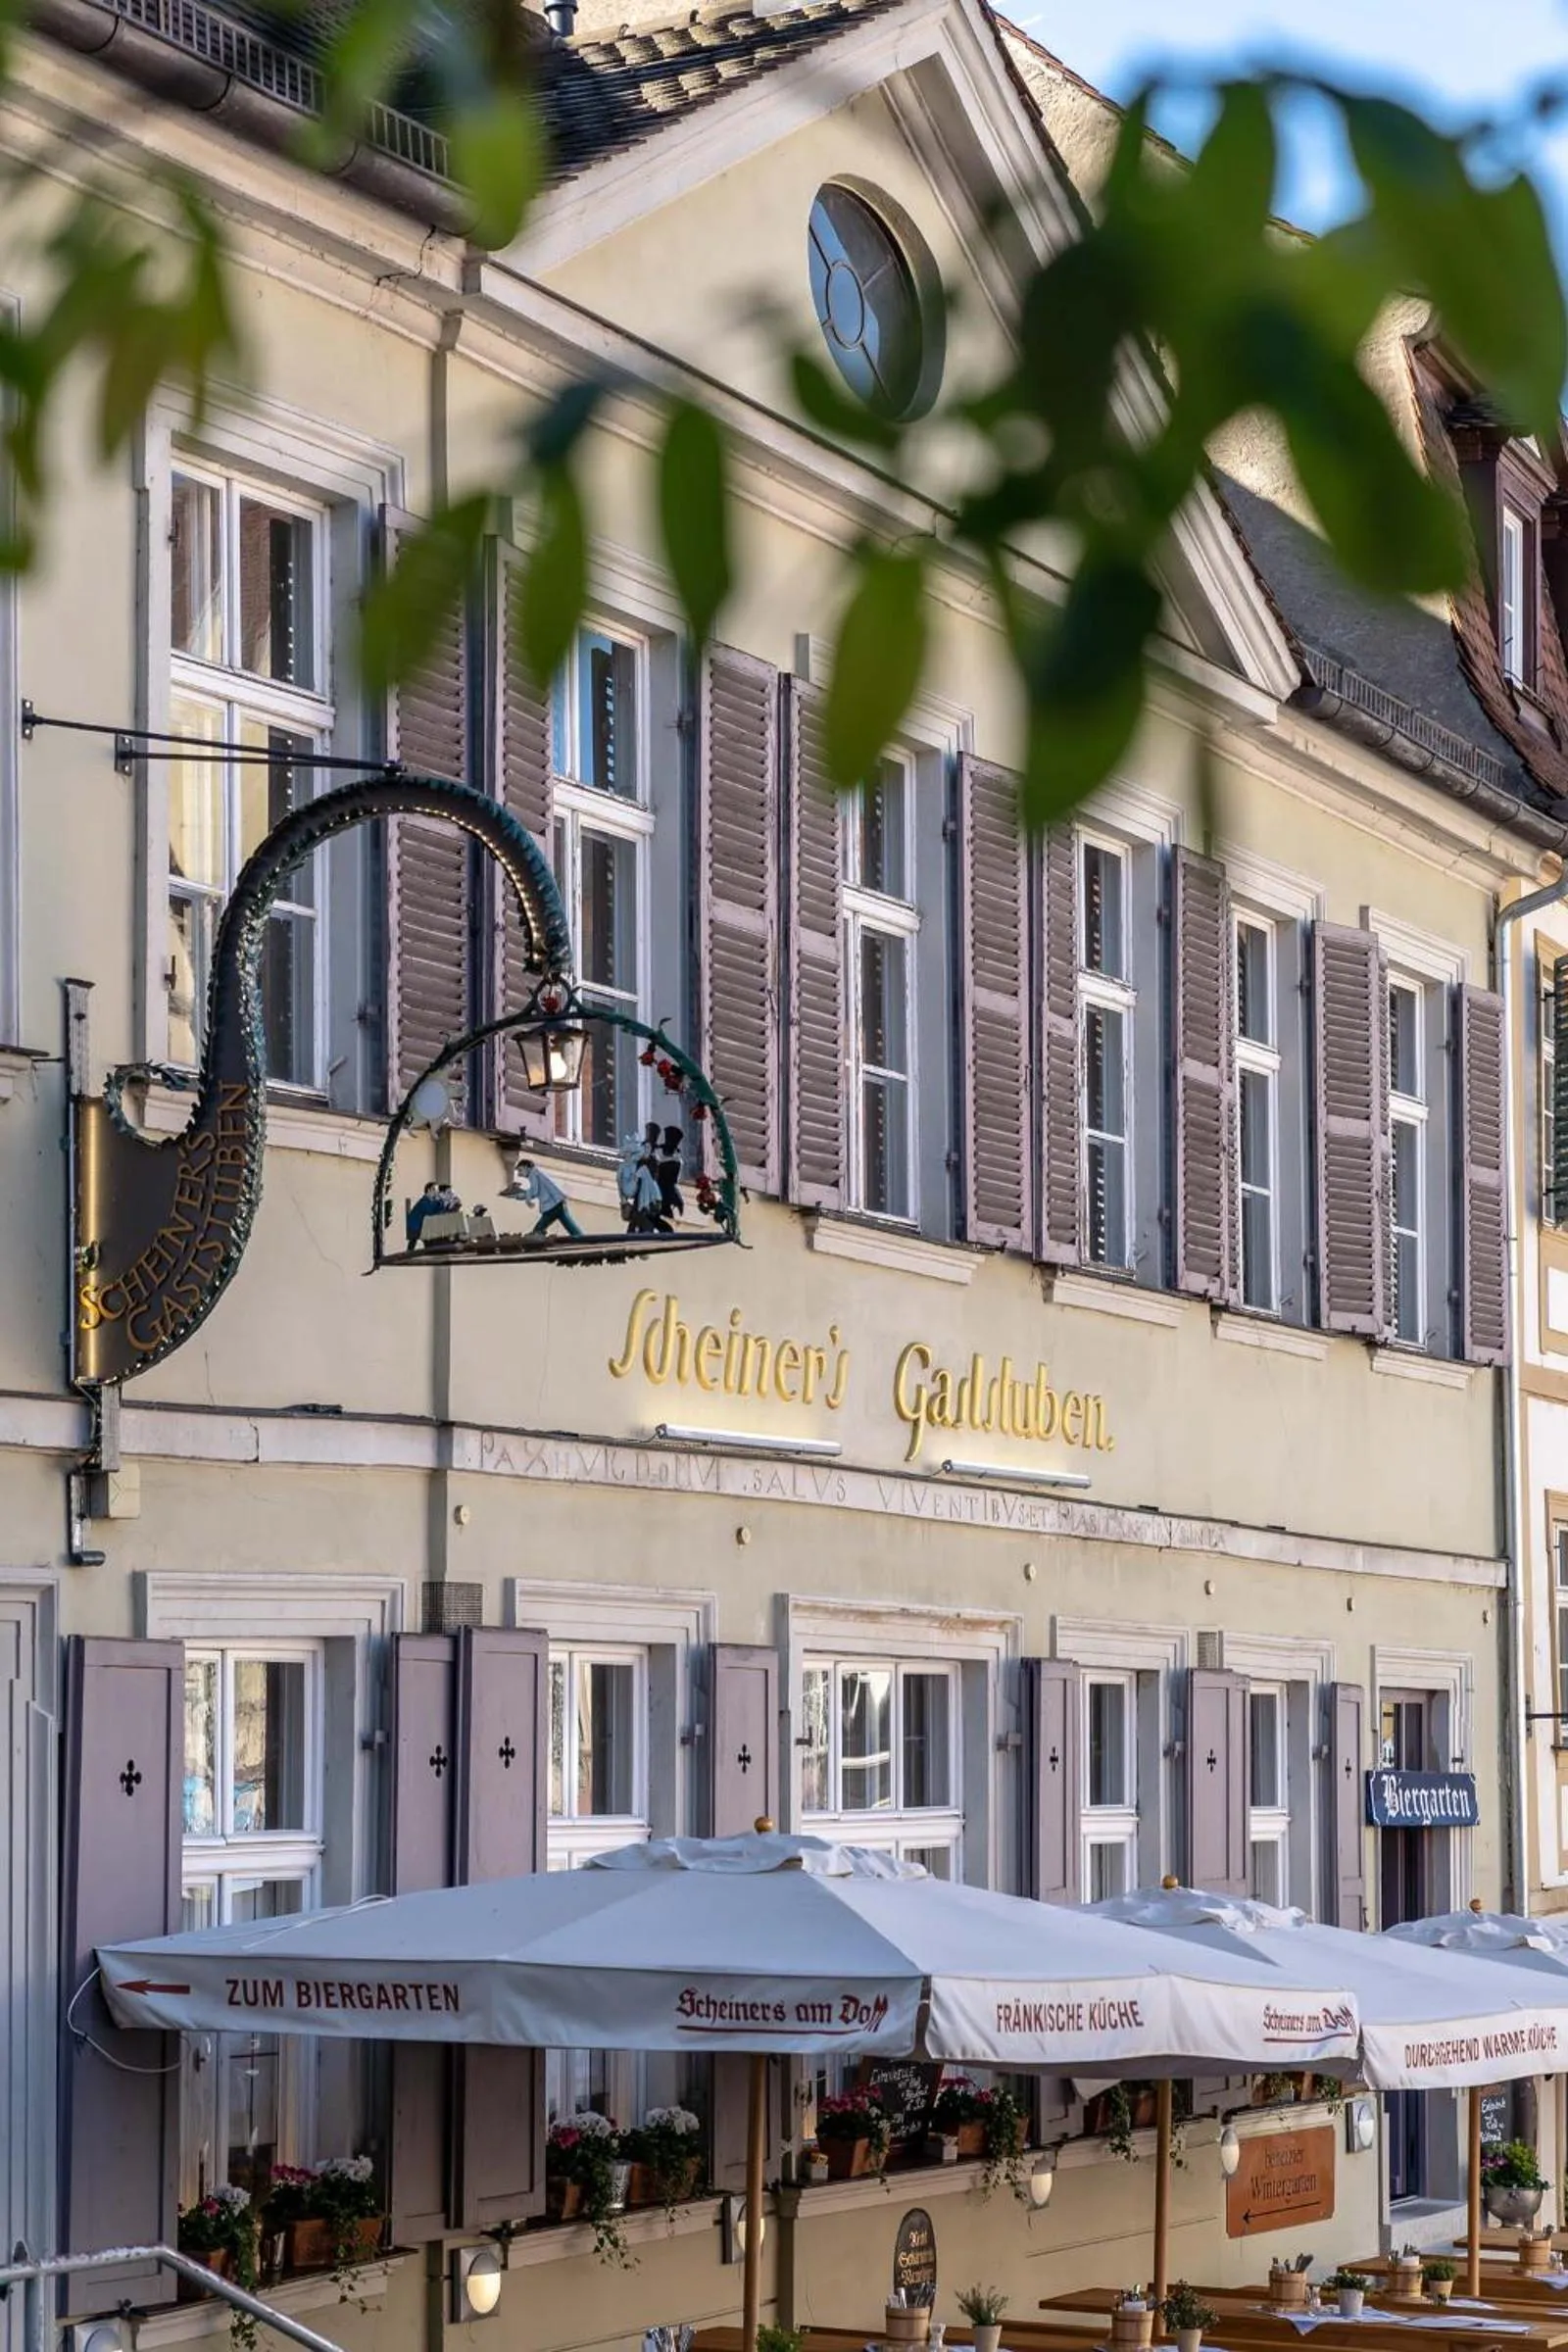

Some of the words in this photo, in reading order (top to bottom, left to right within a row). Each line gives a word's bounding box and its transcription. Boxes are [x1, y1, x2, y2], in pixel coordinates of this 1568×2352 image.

[79, 1131, 218, 1330] SCHEINER'S
[127, 1083, 247, 1351] GASTSTUBEN
[609, 1288, 850, 1409] Scheiner's
[480, 1430, 549, 1474] PAX
[1381, 1774, 1472, 1826] Biergarten
[225, 1978, 285, 2008] ZUM
[296, 1979, 461, 2013] BIERGARTEN
[675, 1985, 787, 2026] Scheiners
[795, 2001, 833, 2025] am
[996, 1997, 1084, 2034] FRÄNKISCHE
[1088, 1996, 1145, 2032] KÜCHE
[1403, 2037, 1480, 2070] DURCHGEHEND
[1483, 2029, 1527, 2060] WARME
[1527, 2022, 1558, 2053] KÜCHE
